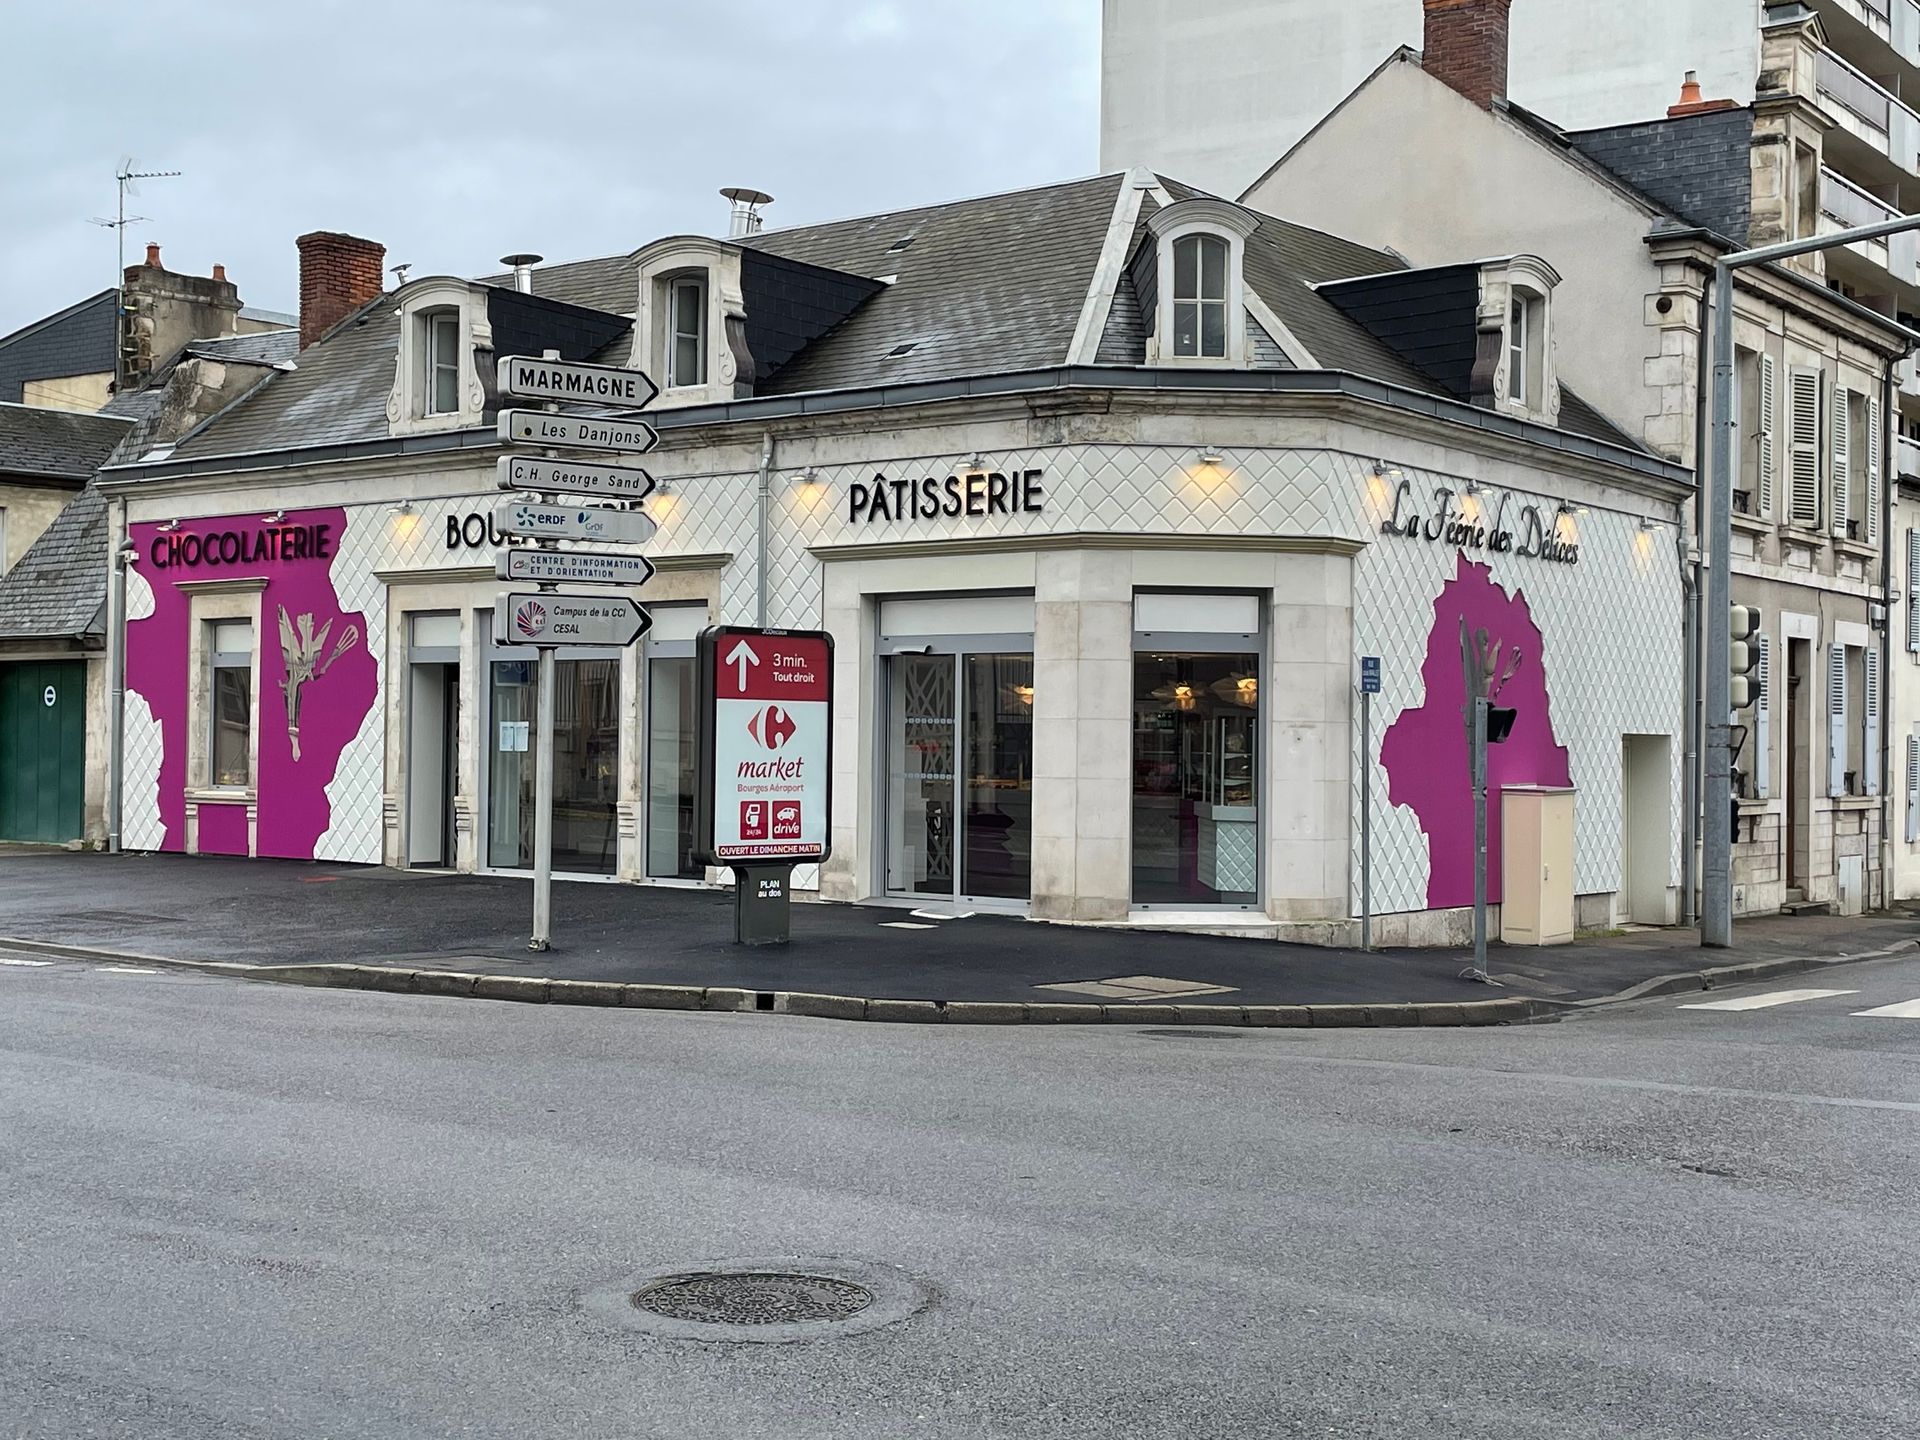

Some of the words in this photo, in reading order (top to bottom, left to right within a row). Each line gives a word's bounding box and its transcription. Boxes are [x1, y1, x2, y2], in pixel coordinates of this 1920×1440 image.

[519, 367, 636, 399] MARMAGNE
[541, 422, 567, 438] Les
[579, 425, 641, 445] Danjons
[514, 466, 542, 481] C.H.
[551, 470, 599, 488] George
[608, 475, 640, 489] Sand
[849, 469, 1043, 523] PÂTISSERIE
[1381, 479, 1420, 537] La
[1488, 492, 1513, 553] des
[1517, 504, 1579, 565] Délices
[150, 524, 331, 569] CHOCOLATERIE
[530, 555, 565, 566] CENTRE
[571, 559, 639, 570] D'INFORMATION
[530, 567, 541, 575] ET
[547, 568, 614, 578] D'ORIENTATION
[553, 605, 588, 619] Campus
[589, 607, 600, 617] de
[601, 607, 610, 618] la
[611, 607, 626, 618] CCI
[553, 623, 580, 634] CESAL
[773, 653, 781, 667] 3
[783, 653, 808, 668] min.
[773, 671, 793, 682] Tout
[793, 672, 815, 683] droit
[737, 756, 805, 781] market
[737, 783, 769, 795] Bourges
[769, 784, 804, 794] Aéroport
[773, 822, 800, 834] drive
[720, 846, 749, 855] OUVERT
[749, 846, 759, 854] LE
[759, 844, 798, 854] DIMANCHE
[798, 843, 820, 853] MATIN
[760, 880, 780, 889] PLAN
[768, 889, 781, 897] dos
